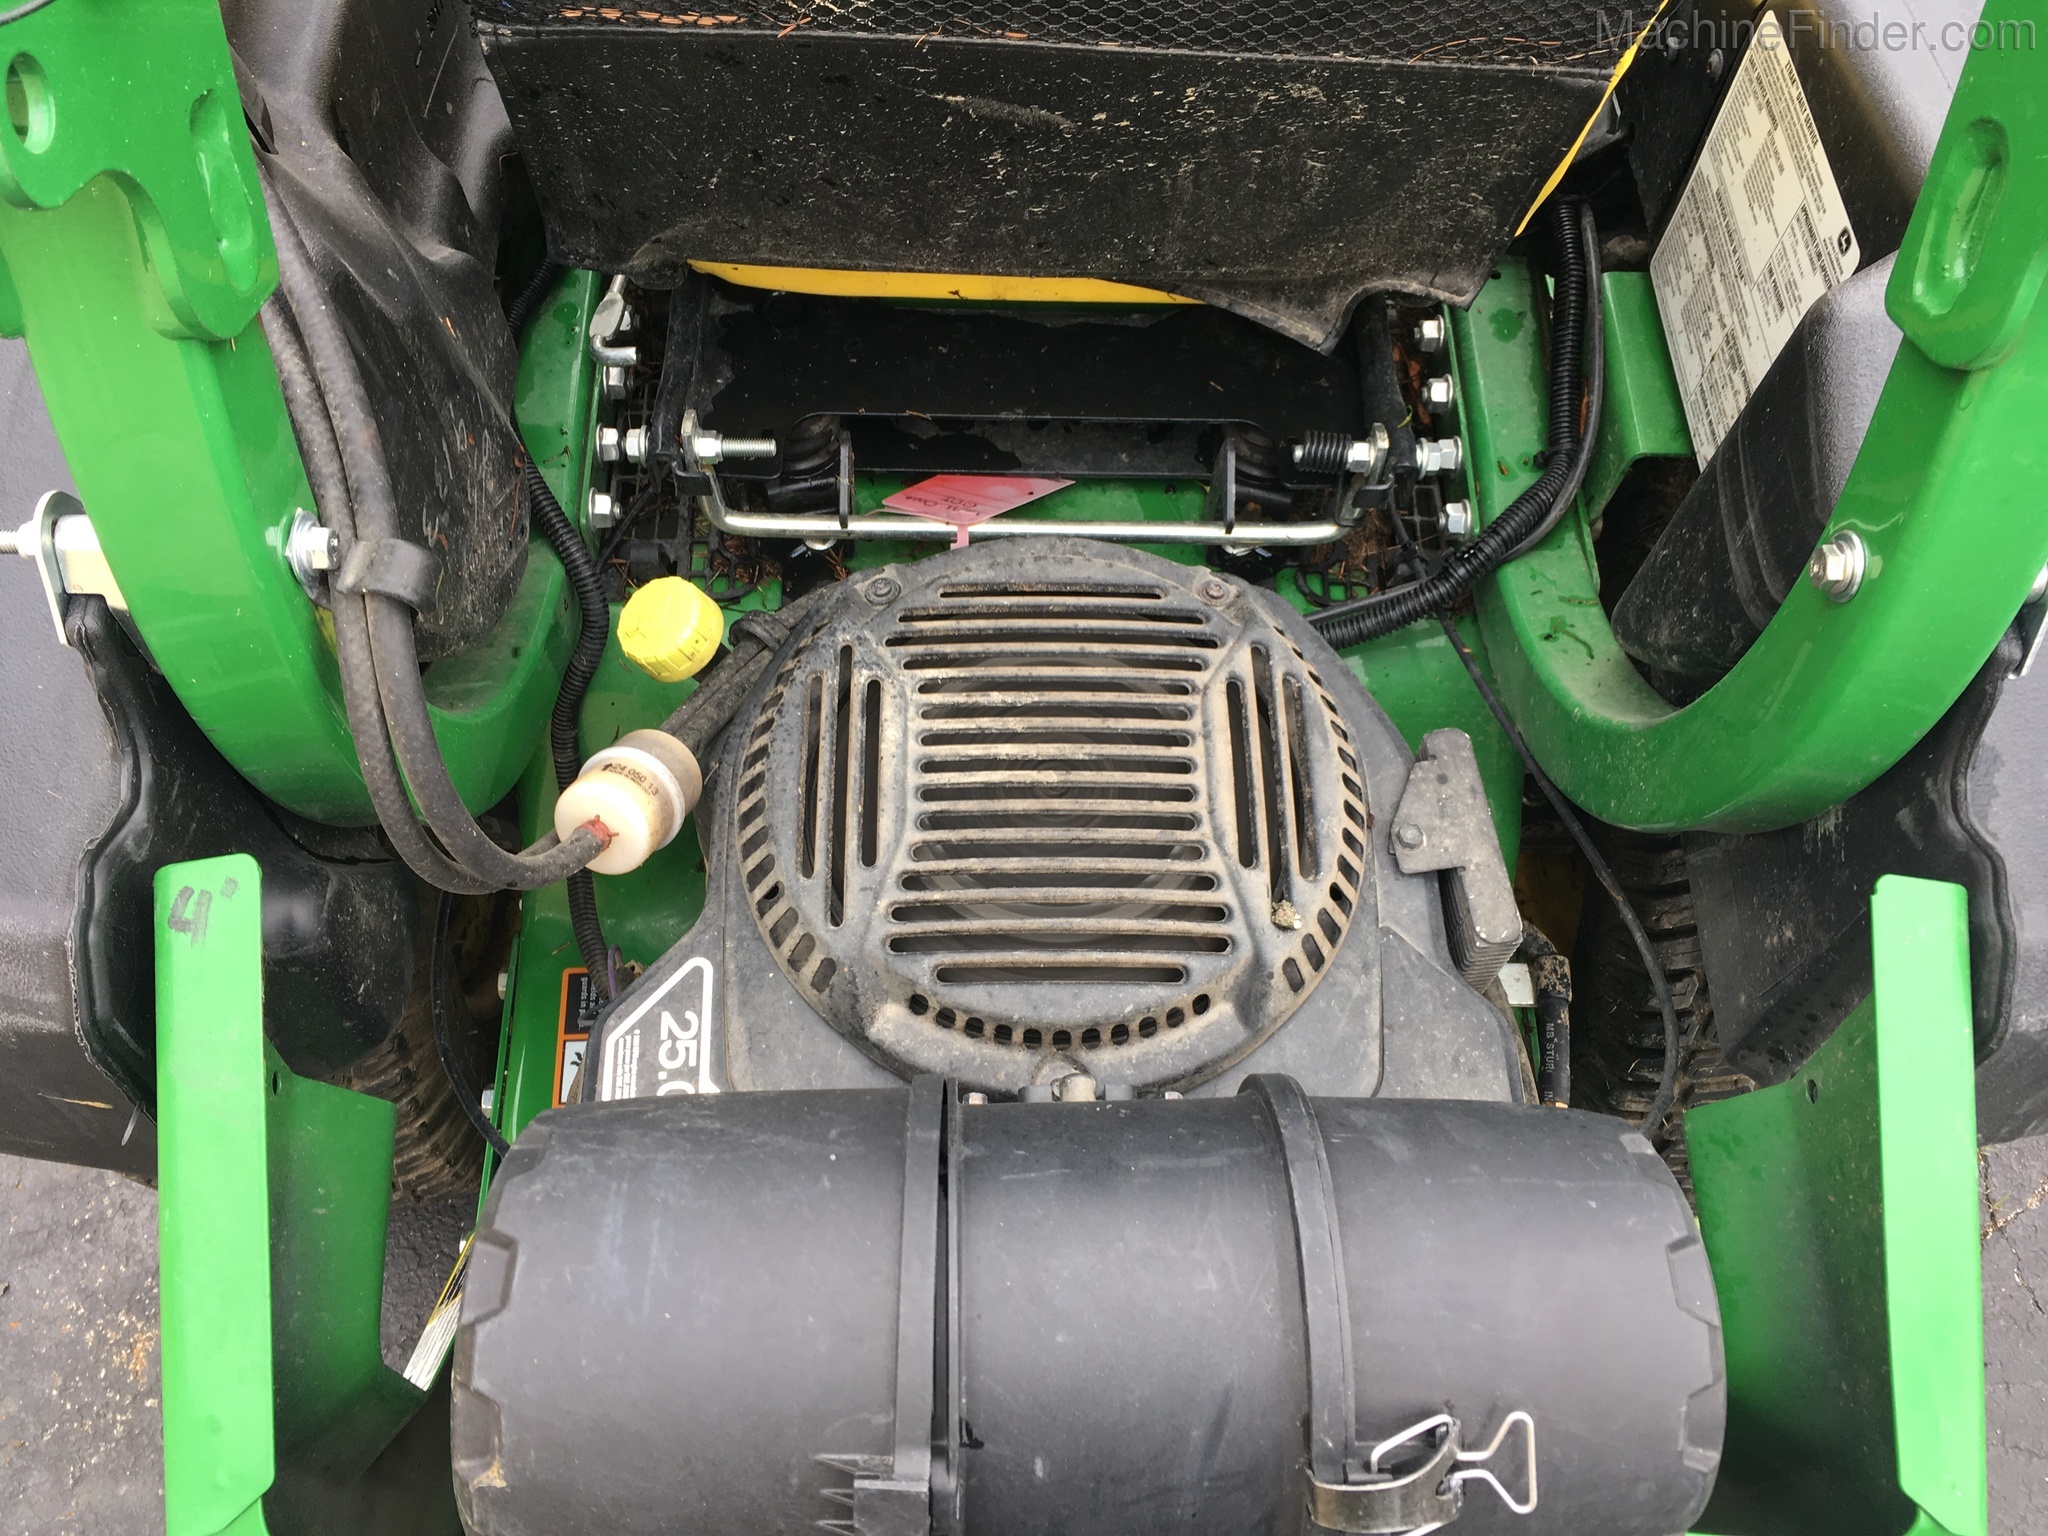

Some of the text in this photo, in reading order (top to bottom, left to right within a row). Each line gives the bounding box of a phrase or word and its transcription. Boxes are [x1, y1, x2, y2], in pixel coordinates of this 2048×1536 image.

[1795, 89, 1807, 117] DAILY
[1803, 111, 1819, 150] SERVICE
[628, 768, 647, 783] 050
[648, 782, 659, 796] 13
